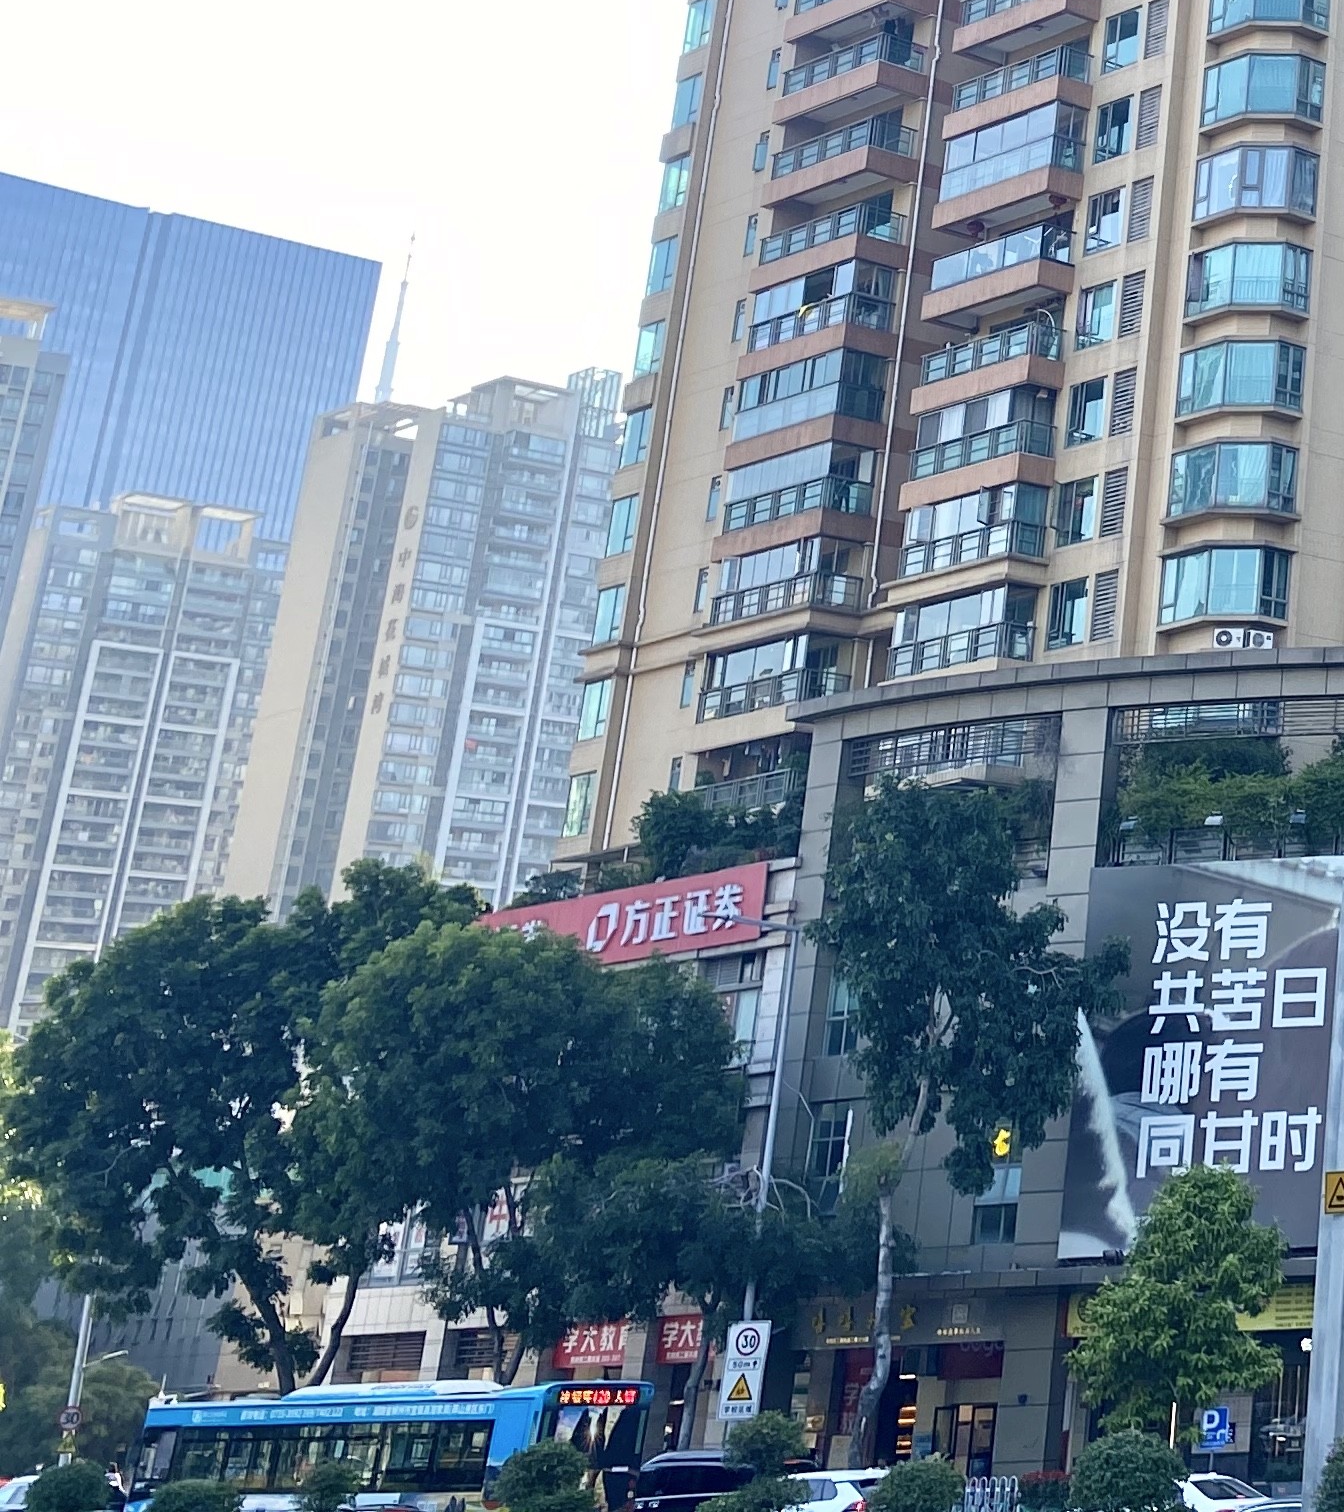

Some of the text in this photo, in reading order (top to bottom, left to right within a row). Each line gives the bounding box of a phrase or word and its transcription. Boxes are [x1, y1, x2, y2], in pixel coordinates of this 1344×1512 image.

[620, 884, 744, 947] 方正证券
[1151, 898, 1273, 964] 没有
[1149, 967, 1327, 1034] 共苦日
[1140, 1038, 1264, 1105] 哪有
[1136, 1106, 1323, 1179] 同甘时
[741, 1333, 757, 1350] 30
